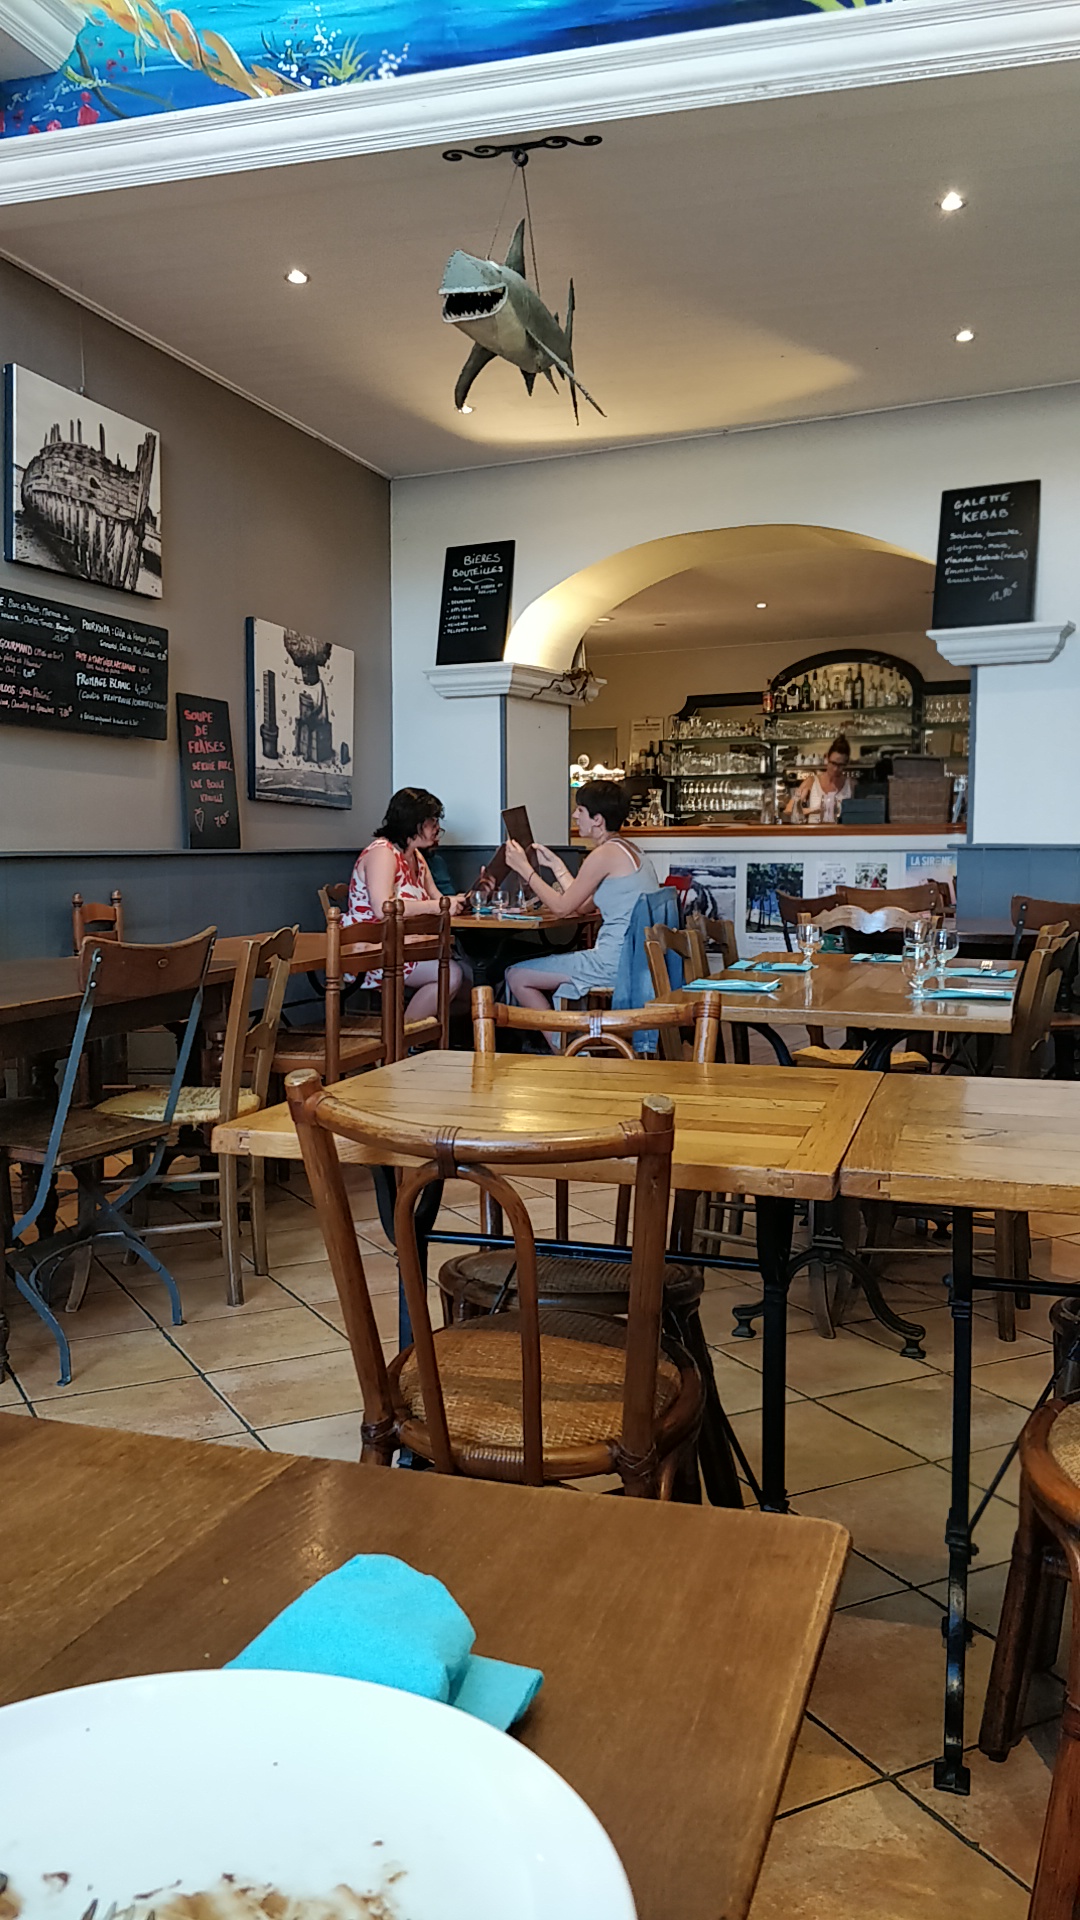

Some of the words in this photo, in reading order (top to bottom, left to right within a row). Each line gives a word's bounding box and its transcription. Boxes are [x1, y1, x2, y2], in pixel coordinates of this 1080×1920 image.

[953, 492, 1011, 510] GALETTE
[76, 672, 107, 688] FROMAGE
[109, 677, 131, 691] BLANC
[183, 709, 213, 722] SOUPE
[194, 724, 208, 737] DE
[910, 855, 921, 866] LA
